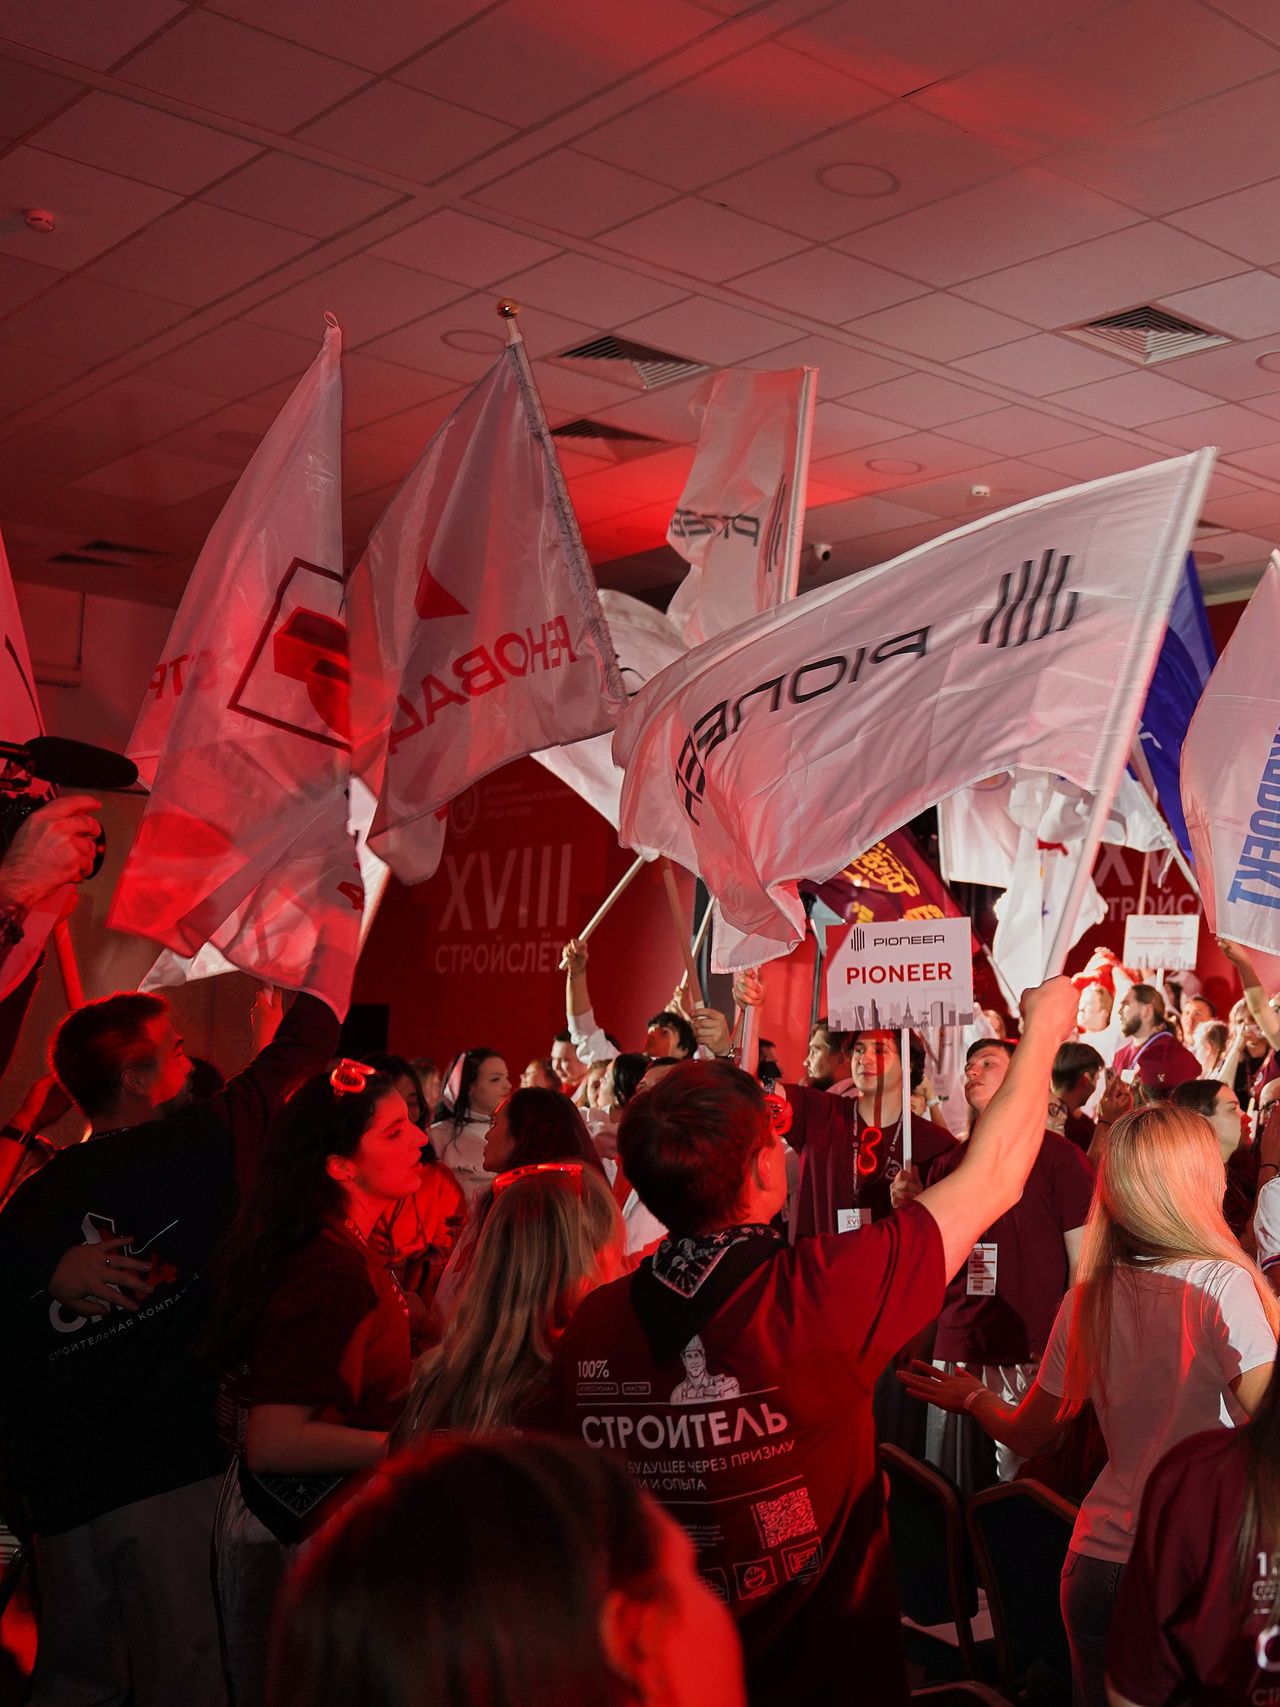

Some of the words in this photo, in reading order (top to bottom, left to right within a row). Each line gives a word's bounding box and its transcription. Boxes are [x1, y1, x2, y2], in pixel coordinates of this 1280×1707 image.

[438, 842, 574, 932] XVIII
[873, 934, 945, 947] PIONEER
[846, 962, 952, 985] PIONEER
[577, 1359, 610, 1379] 100%
[581, 1402, 788, 1450] СТРОИТЕЛЬ
[627, 1460, 687, 1475] БУДУЩЕЕ
[687, 1457, 728, 1473] ЧЕРЕЗ
[731, 1438, 795, 1468] ПРИЗМУ
[662, 1478, 707, 1491] ОПЫТА
